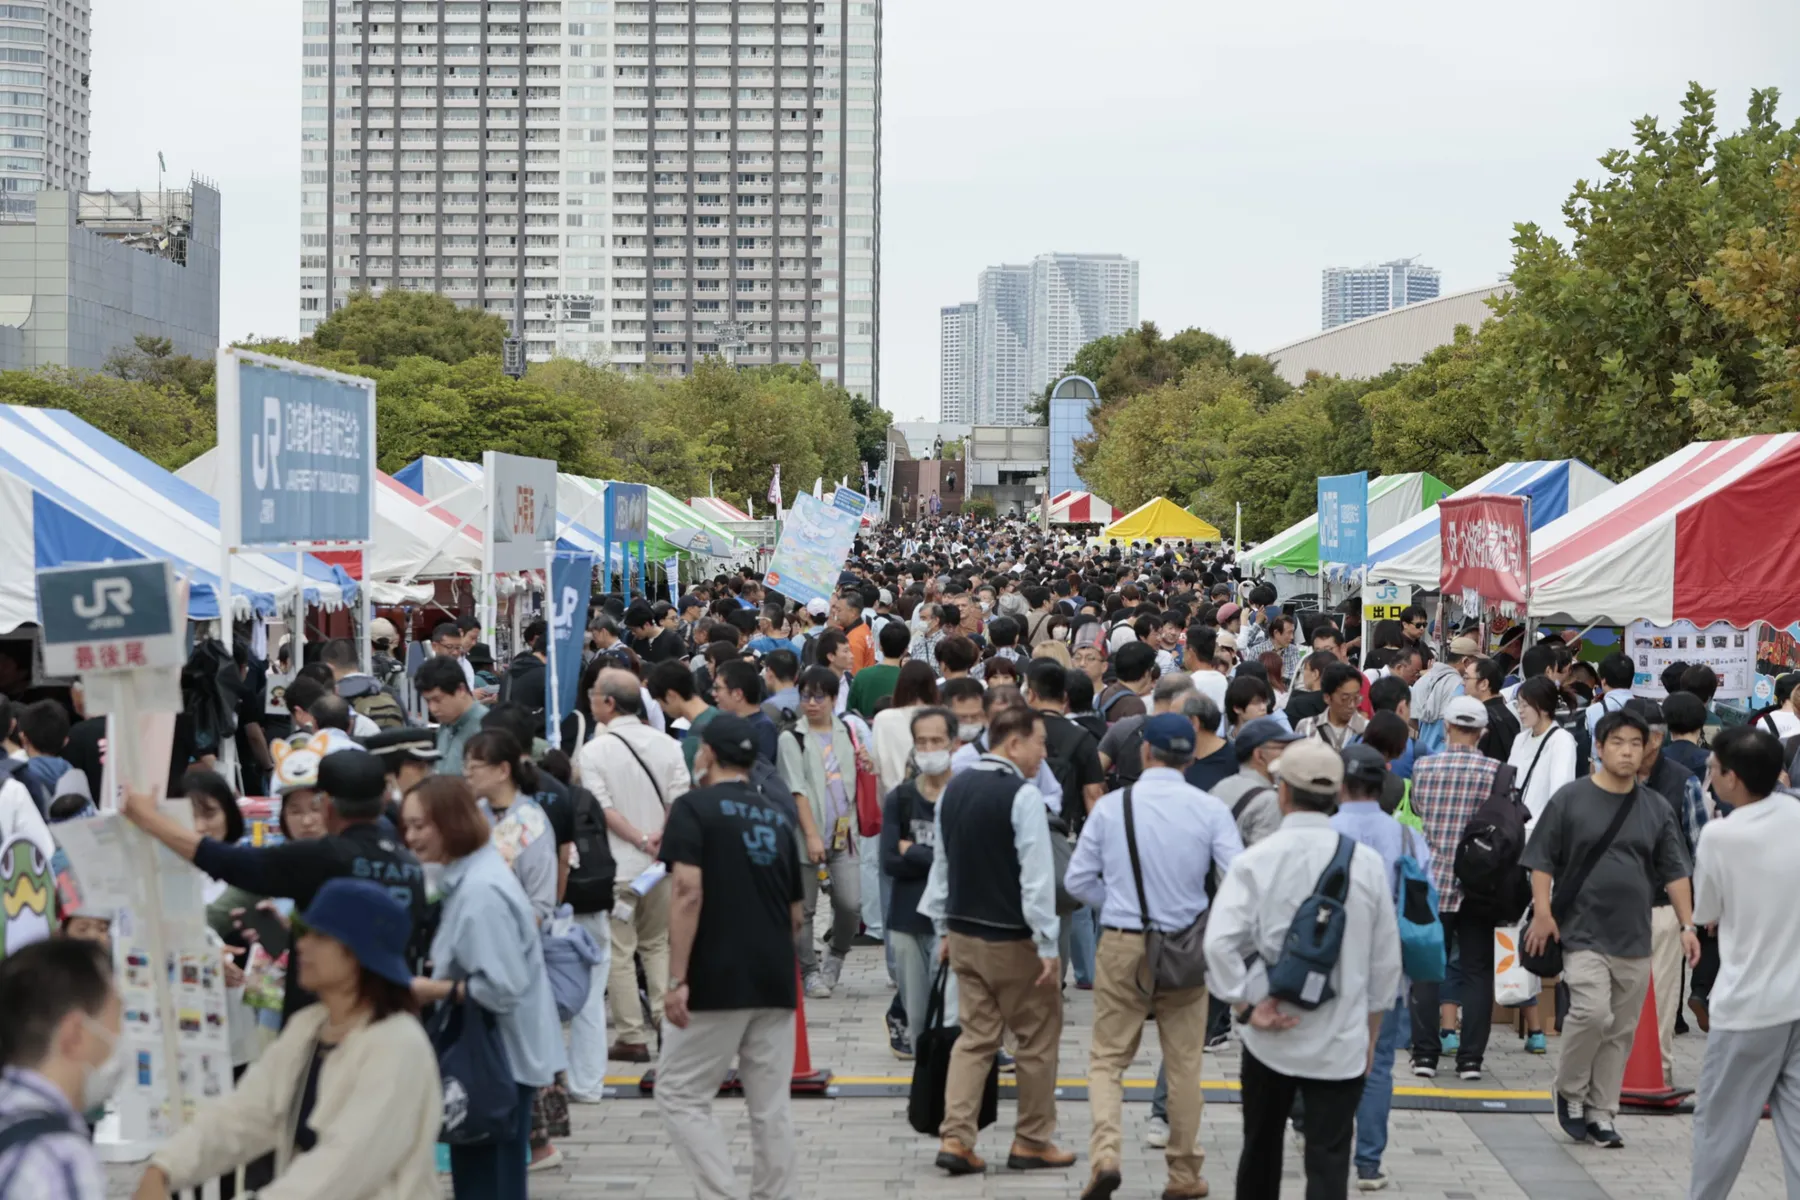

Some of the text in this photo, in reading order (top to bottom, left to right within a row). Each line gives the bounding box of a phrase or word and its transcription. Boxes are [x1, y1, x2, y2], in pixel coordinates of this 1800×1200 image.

[252, 396, 282, 491] JR
[72, 576, 134, 619] JR
[1375, 585, 1398, 600] JR
[1372, 606, 1402, 619] 出口
[75, 640, 148, 671] 最後尾
[742, 824, 778, 853] JR
